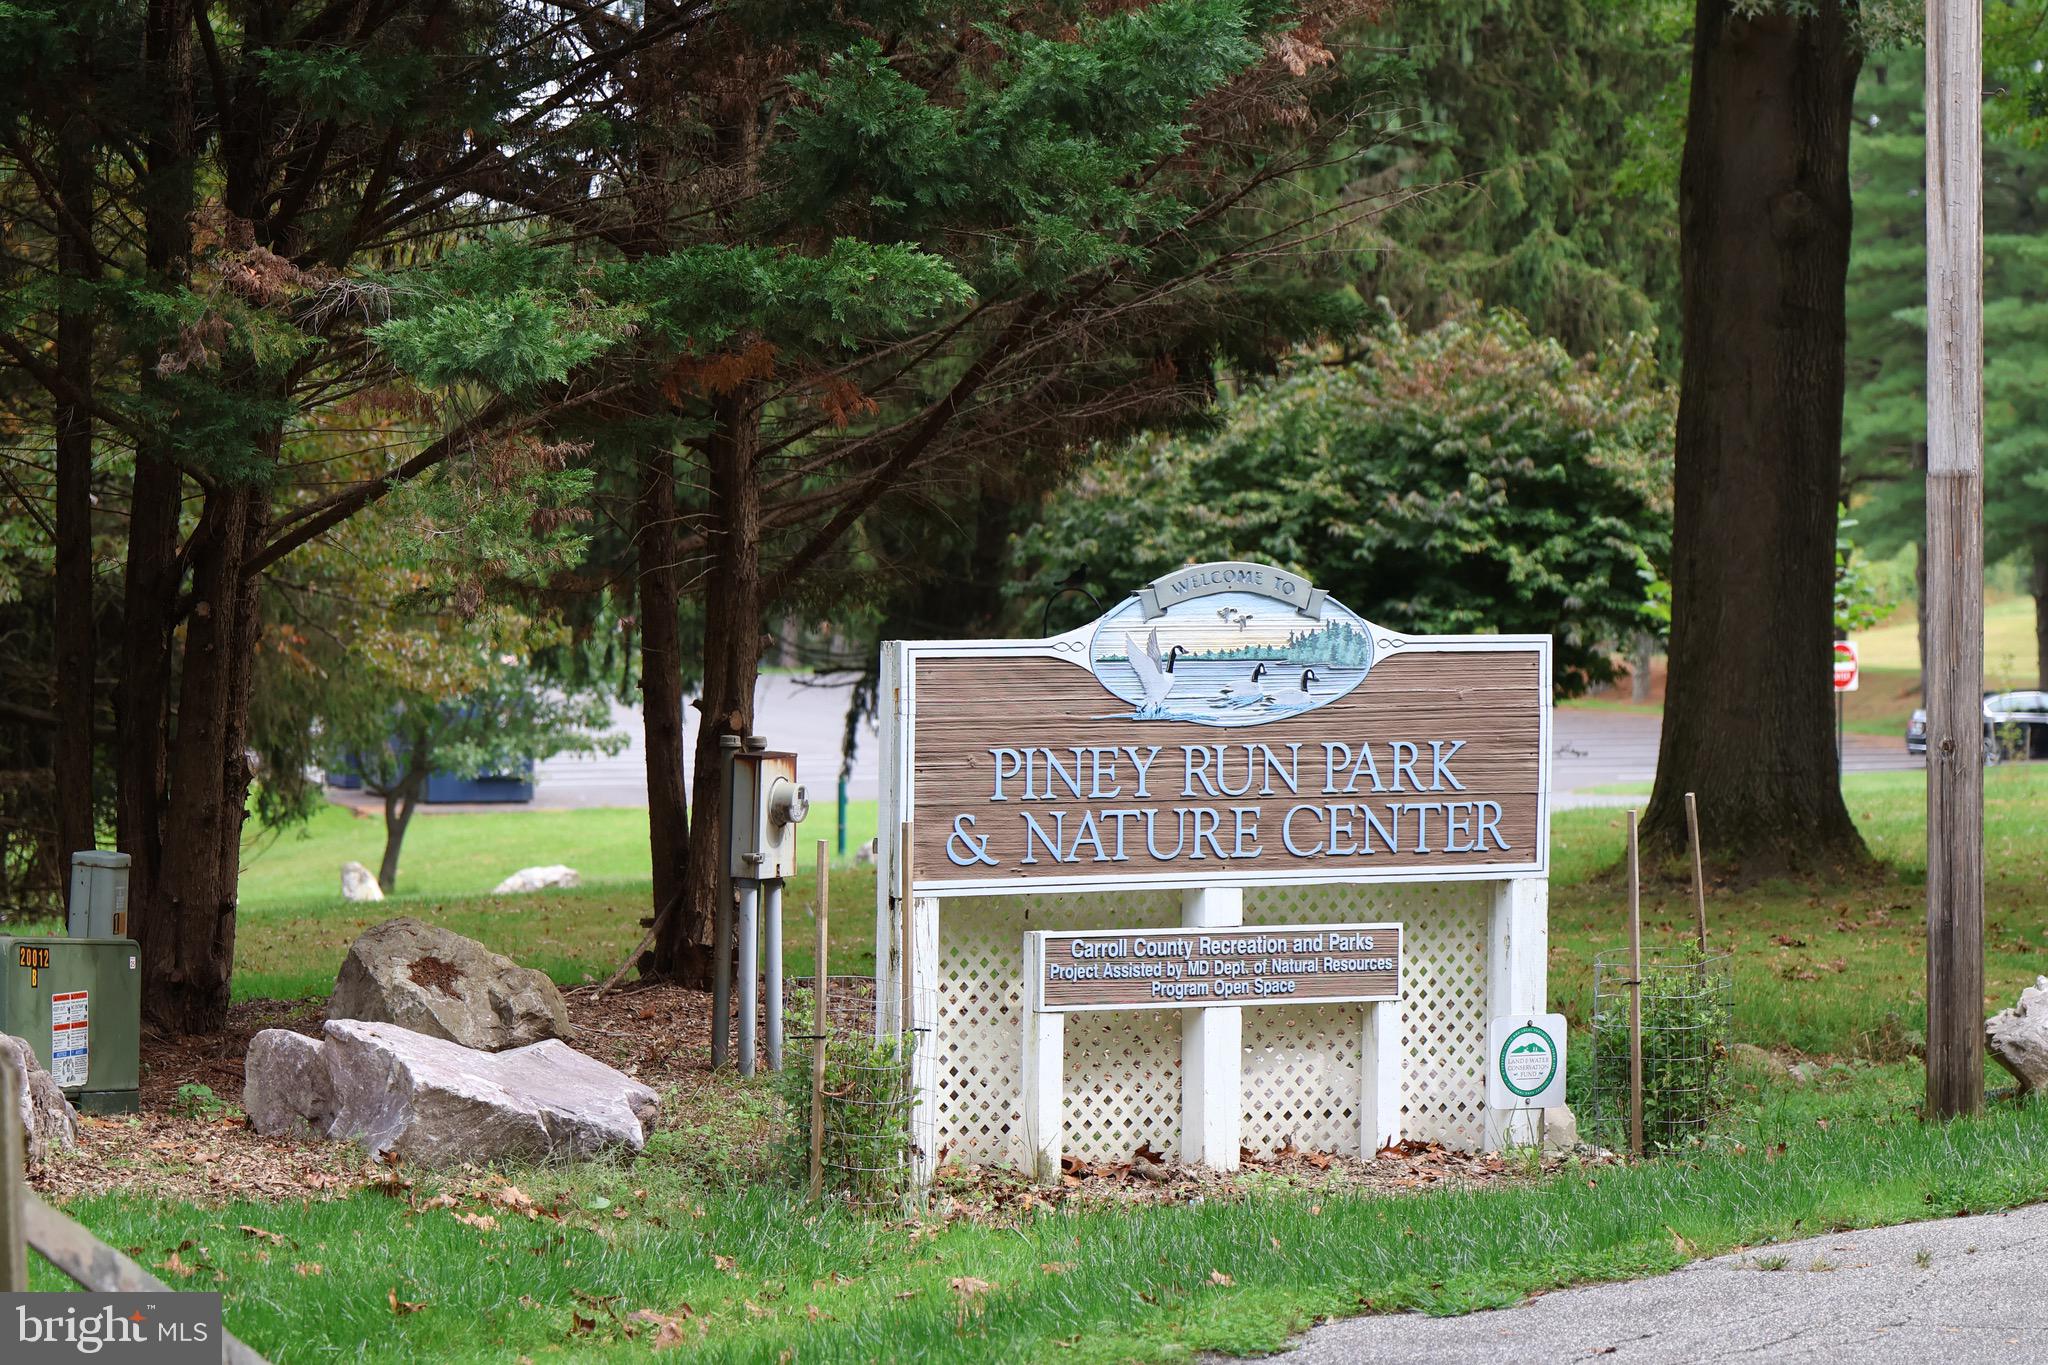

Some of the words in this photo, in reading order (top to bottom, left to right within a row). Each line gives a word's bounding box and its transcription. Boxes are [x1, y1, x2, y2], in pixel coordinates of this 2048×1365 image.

[1171, 570, 1264, 595] WELCOME
[1274, 577, 1296, 595] TO
[989, 746, 1163, 801] PINEY
[1179, 743, 1303, 798] RUN
[1320, 740, 1467, 794] PARK
[946, 813, 1000, 866] &
[1019, 806, 1264, 865] NATURE
[1281, 800, 1512, 858] CENTER
[20, 947, 49, 967] 20012
[1071, 938, 1128, 958] Carroll
[1133, 937, 1193, 960] County
[1199, 935, 1288, 955] Recreation
[1293, 934, 1323, 953] and
[1328, 933, 1374, 952] Parks
[1050, 962, 1099, 983] Project
[1103, 962, 1162, 979] Assisted
[1166, 961, 1183, 981] by
[1187, 960, 1210, 976] MD
[1214, 959, 1248, 979] Dept.
[1254, 958, 1268, 975] of
[1271, 957, 1319, 974] Natural
[1323, 956, 1393, 972] Resources
[1151, 981, 1209, 1000] Program
[1213, 979, 1249, 999] Open
[1254, 978, 1297, 997] Space
